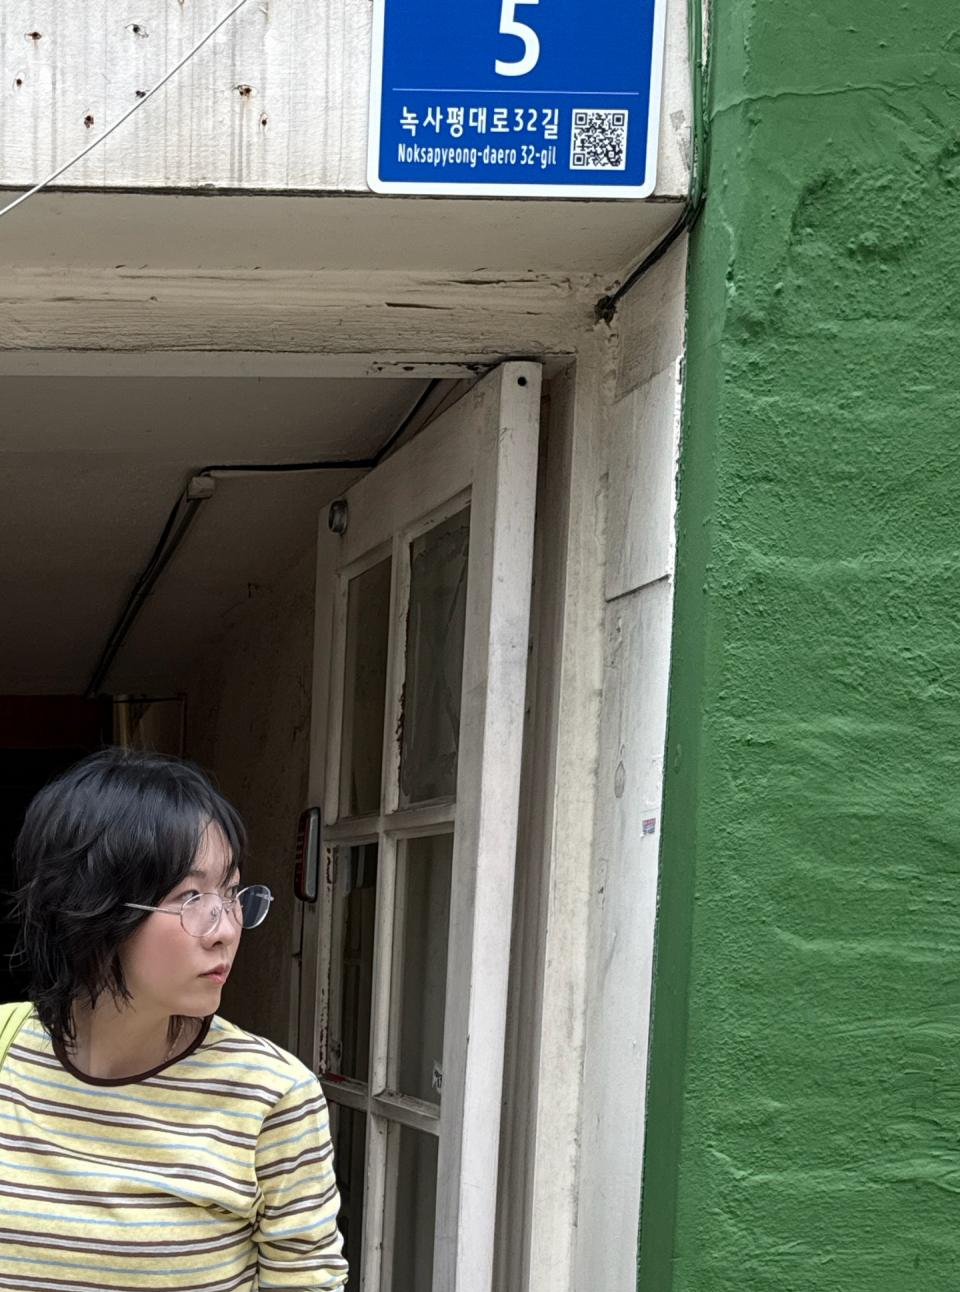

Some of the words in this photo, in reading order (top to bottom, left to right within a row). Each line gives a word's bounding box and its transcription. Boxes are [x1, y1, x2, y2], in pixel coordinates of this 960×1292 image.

[495, 0, 540, 77] 5
[399, 106, 559, 139] 녹사평대로32길
[398, 143, 517, 168] Noksapyeong-daero
[520, 146, 557, 169] 32-gil
